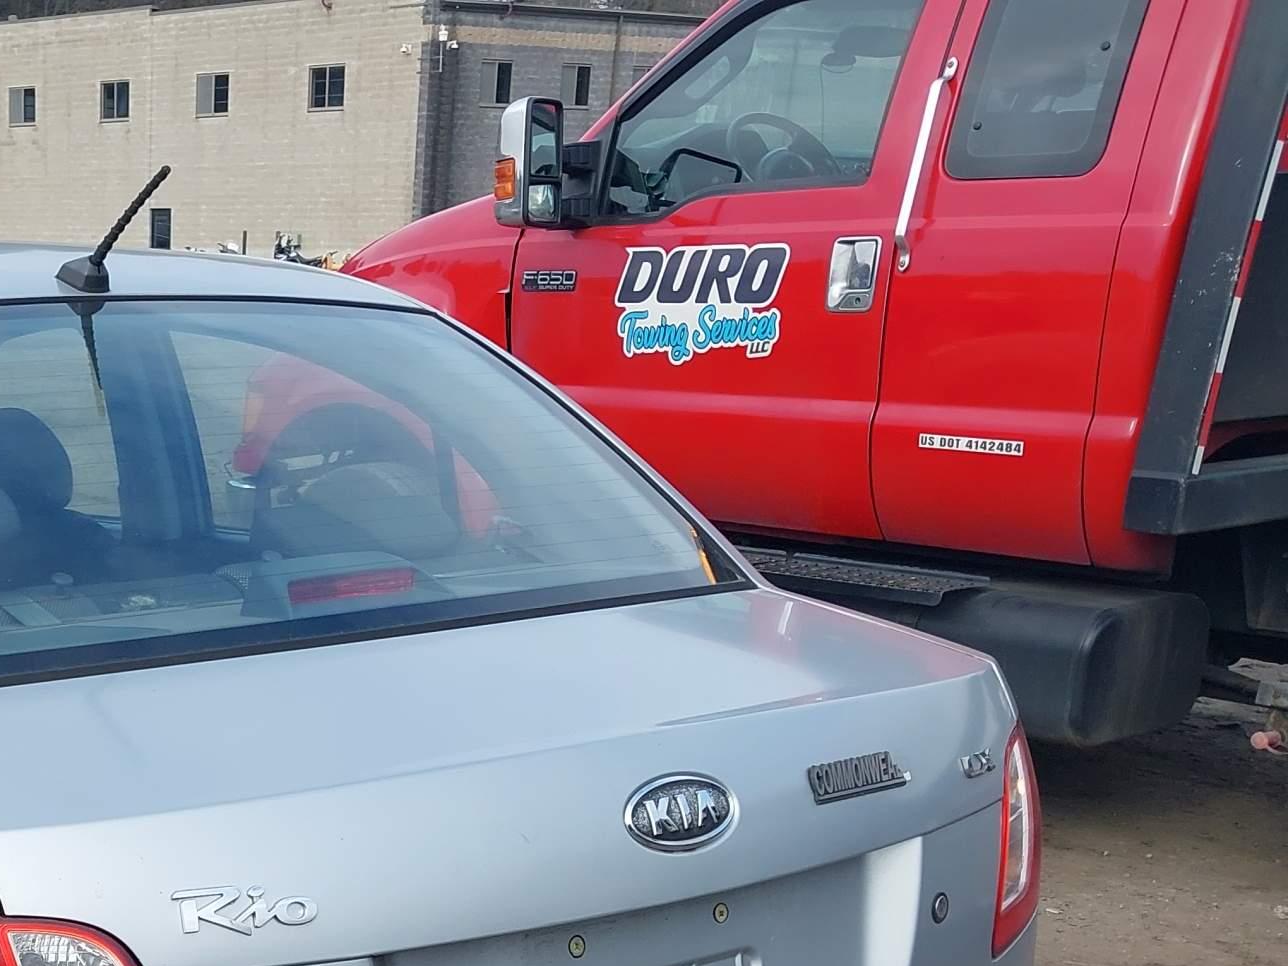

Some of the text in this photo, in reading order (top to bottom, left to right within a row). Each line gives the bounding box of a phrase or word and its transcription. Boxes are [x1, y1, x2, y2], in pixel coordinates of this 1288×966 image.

[617, 247, 787, 304] DURO
[620, 304, 778, 362] Towing Services
[749, 341, 771, 355] LLC
[920, 436, 1022, 453] US DOT 4142484
[643, 789, 719, 836] KIA
[170, 884, 318, 936] Rio
